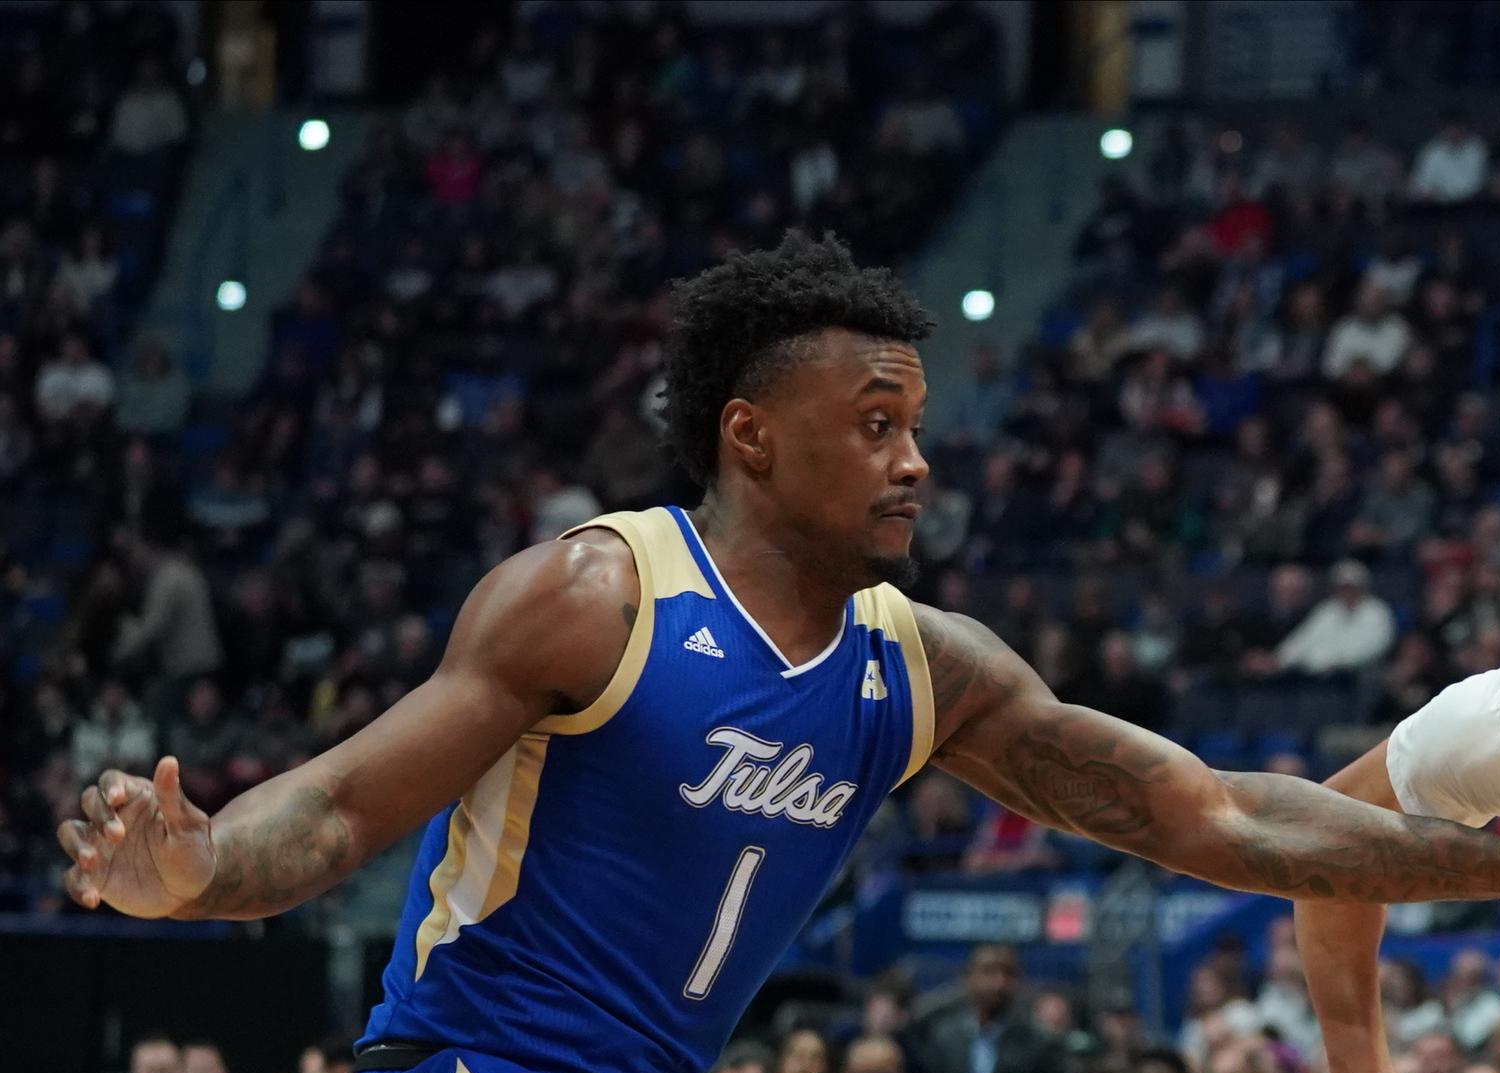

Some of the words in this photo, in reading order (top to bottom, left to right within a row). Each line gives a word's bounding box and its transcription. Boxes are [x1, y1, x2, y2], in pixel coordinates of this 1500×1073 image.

[683, 640, 725, 659] adidas
[678, 726, 859, 829] Tulsa
[682, 845, 766, 1001] 1
